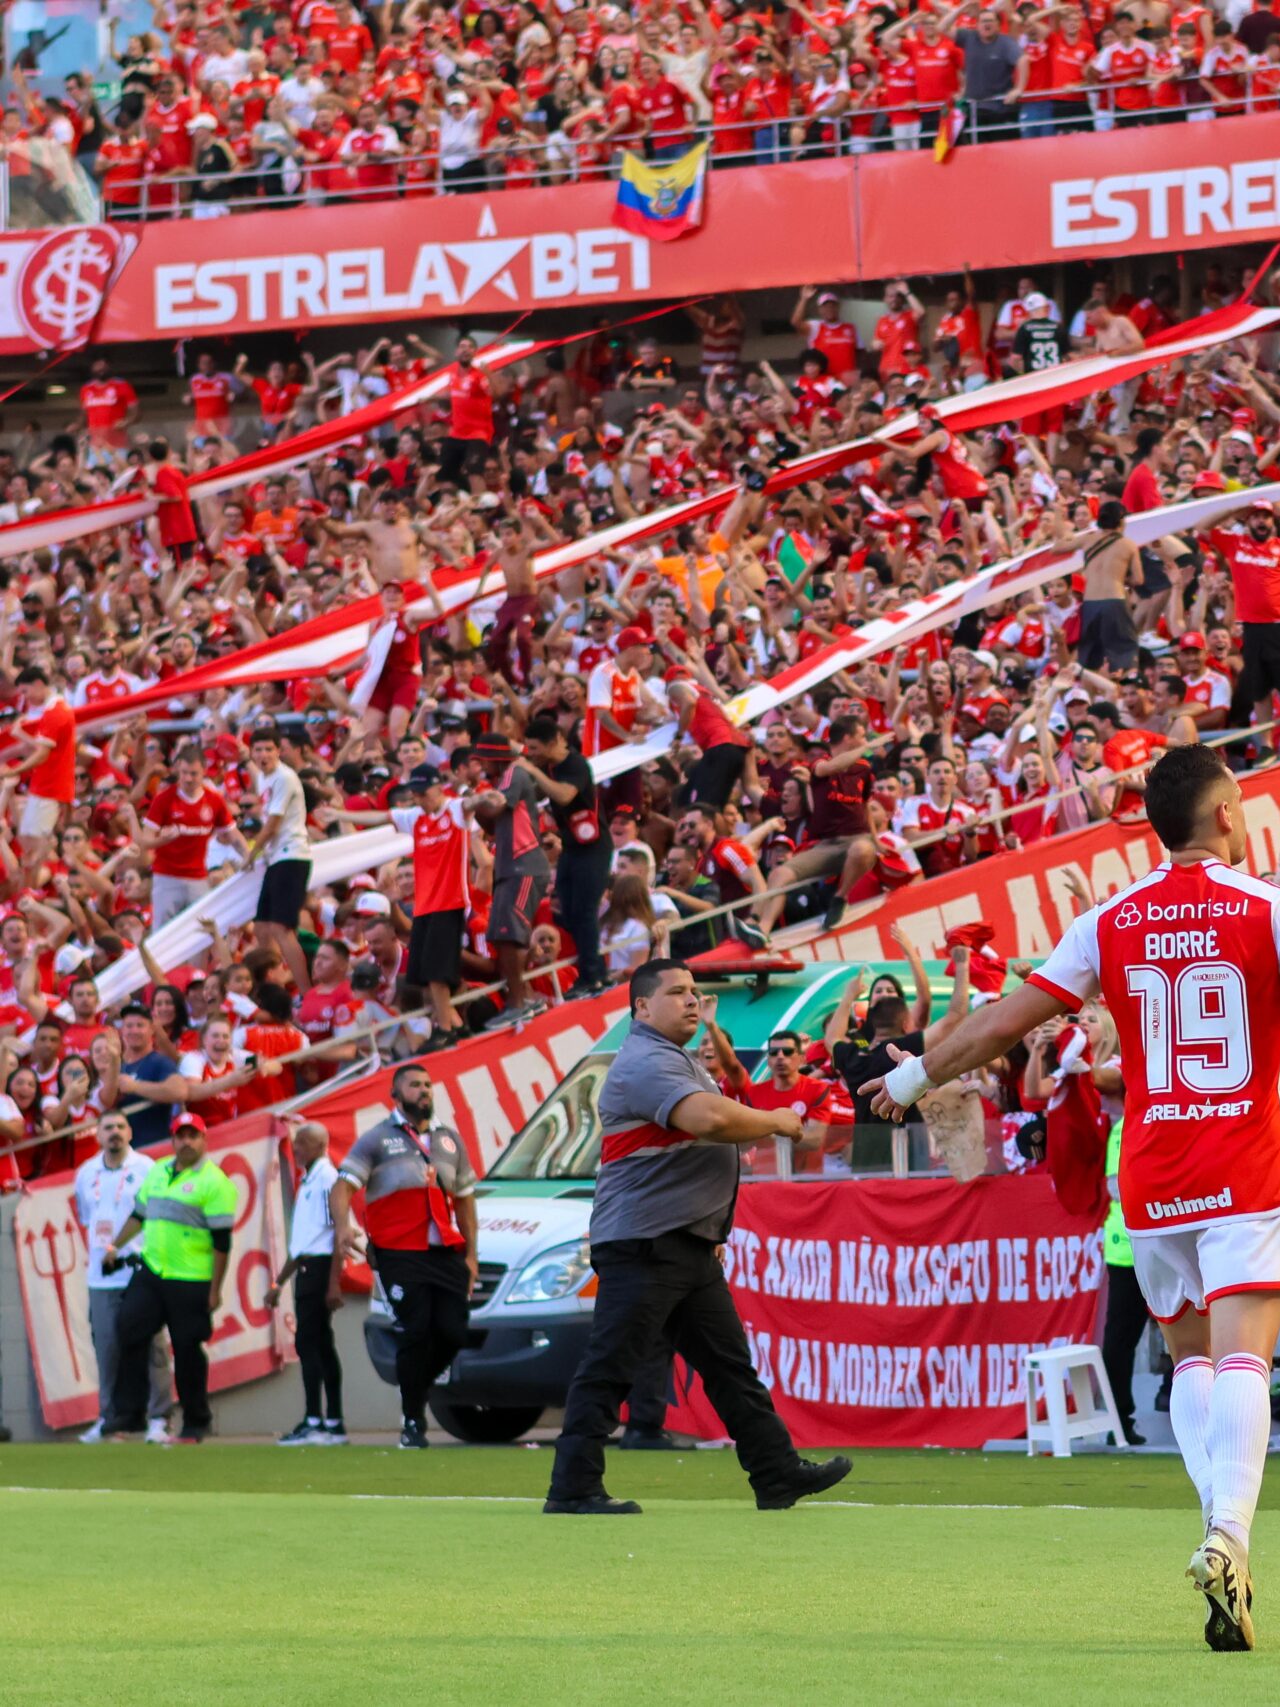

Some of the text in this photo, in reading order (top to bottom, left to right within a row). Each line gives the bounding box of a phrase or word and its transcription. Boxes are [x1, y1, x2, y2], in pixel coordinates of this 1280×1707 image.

[155, 228, 650, 329] ESTRELA BET
[1030, 342, 1060, 369] 33
[1147, 898, 1249, 921] banrisul
[1145, 926, 1220, 960] BORRÉ
[1124, 961, 1253, 1095] 19
[1217, 1100, 1254, 1117] BET
[1146, 1187, 1232, 1220] Unimed
[765, 1237, 831, 1300] AMOR
[838, 1236, 889, 1306] NÃO
[895, 1239, 990, 1306] NASCEU
[997, 1238, 1029, 1301] DE
[779, 1335, 821, 1402] VAI
[827, 1341, 921, 1408] MORRER
[926, 1344, 981, 1408] COM
